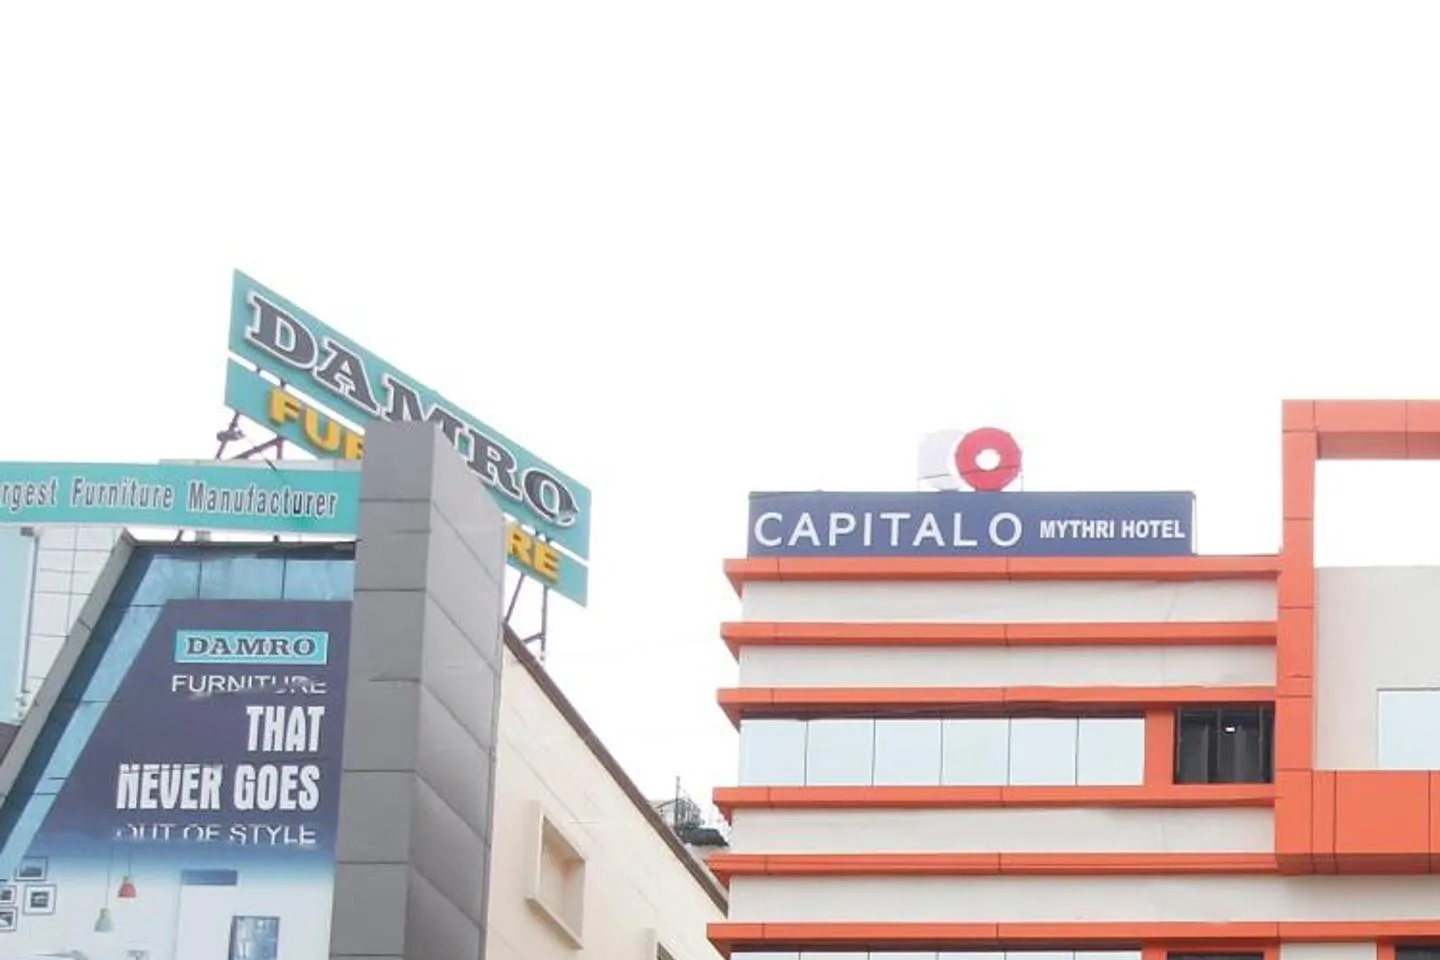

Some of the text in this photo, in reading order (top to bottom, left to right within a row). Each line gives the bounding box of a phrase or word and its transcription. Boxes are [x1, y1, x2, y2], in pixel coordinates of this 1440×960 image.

[71, 477, 173, 508] Furniture
[188, 480, 338, 516] Manufacturer
[1039, 519, 1115, 539] MYTHRI
[1121, 519, 1186, 539] HOTEL
[186, 636, 316, 657] DAMRO
[171, 675, 327, 694] FURNITURE
[246, 705, 325, 752] THAT
[116, 764, 320, 811] NEVER GOES
[183, 823, 222, 842] OF
[229, 824, 317, 846] STYLE
